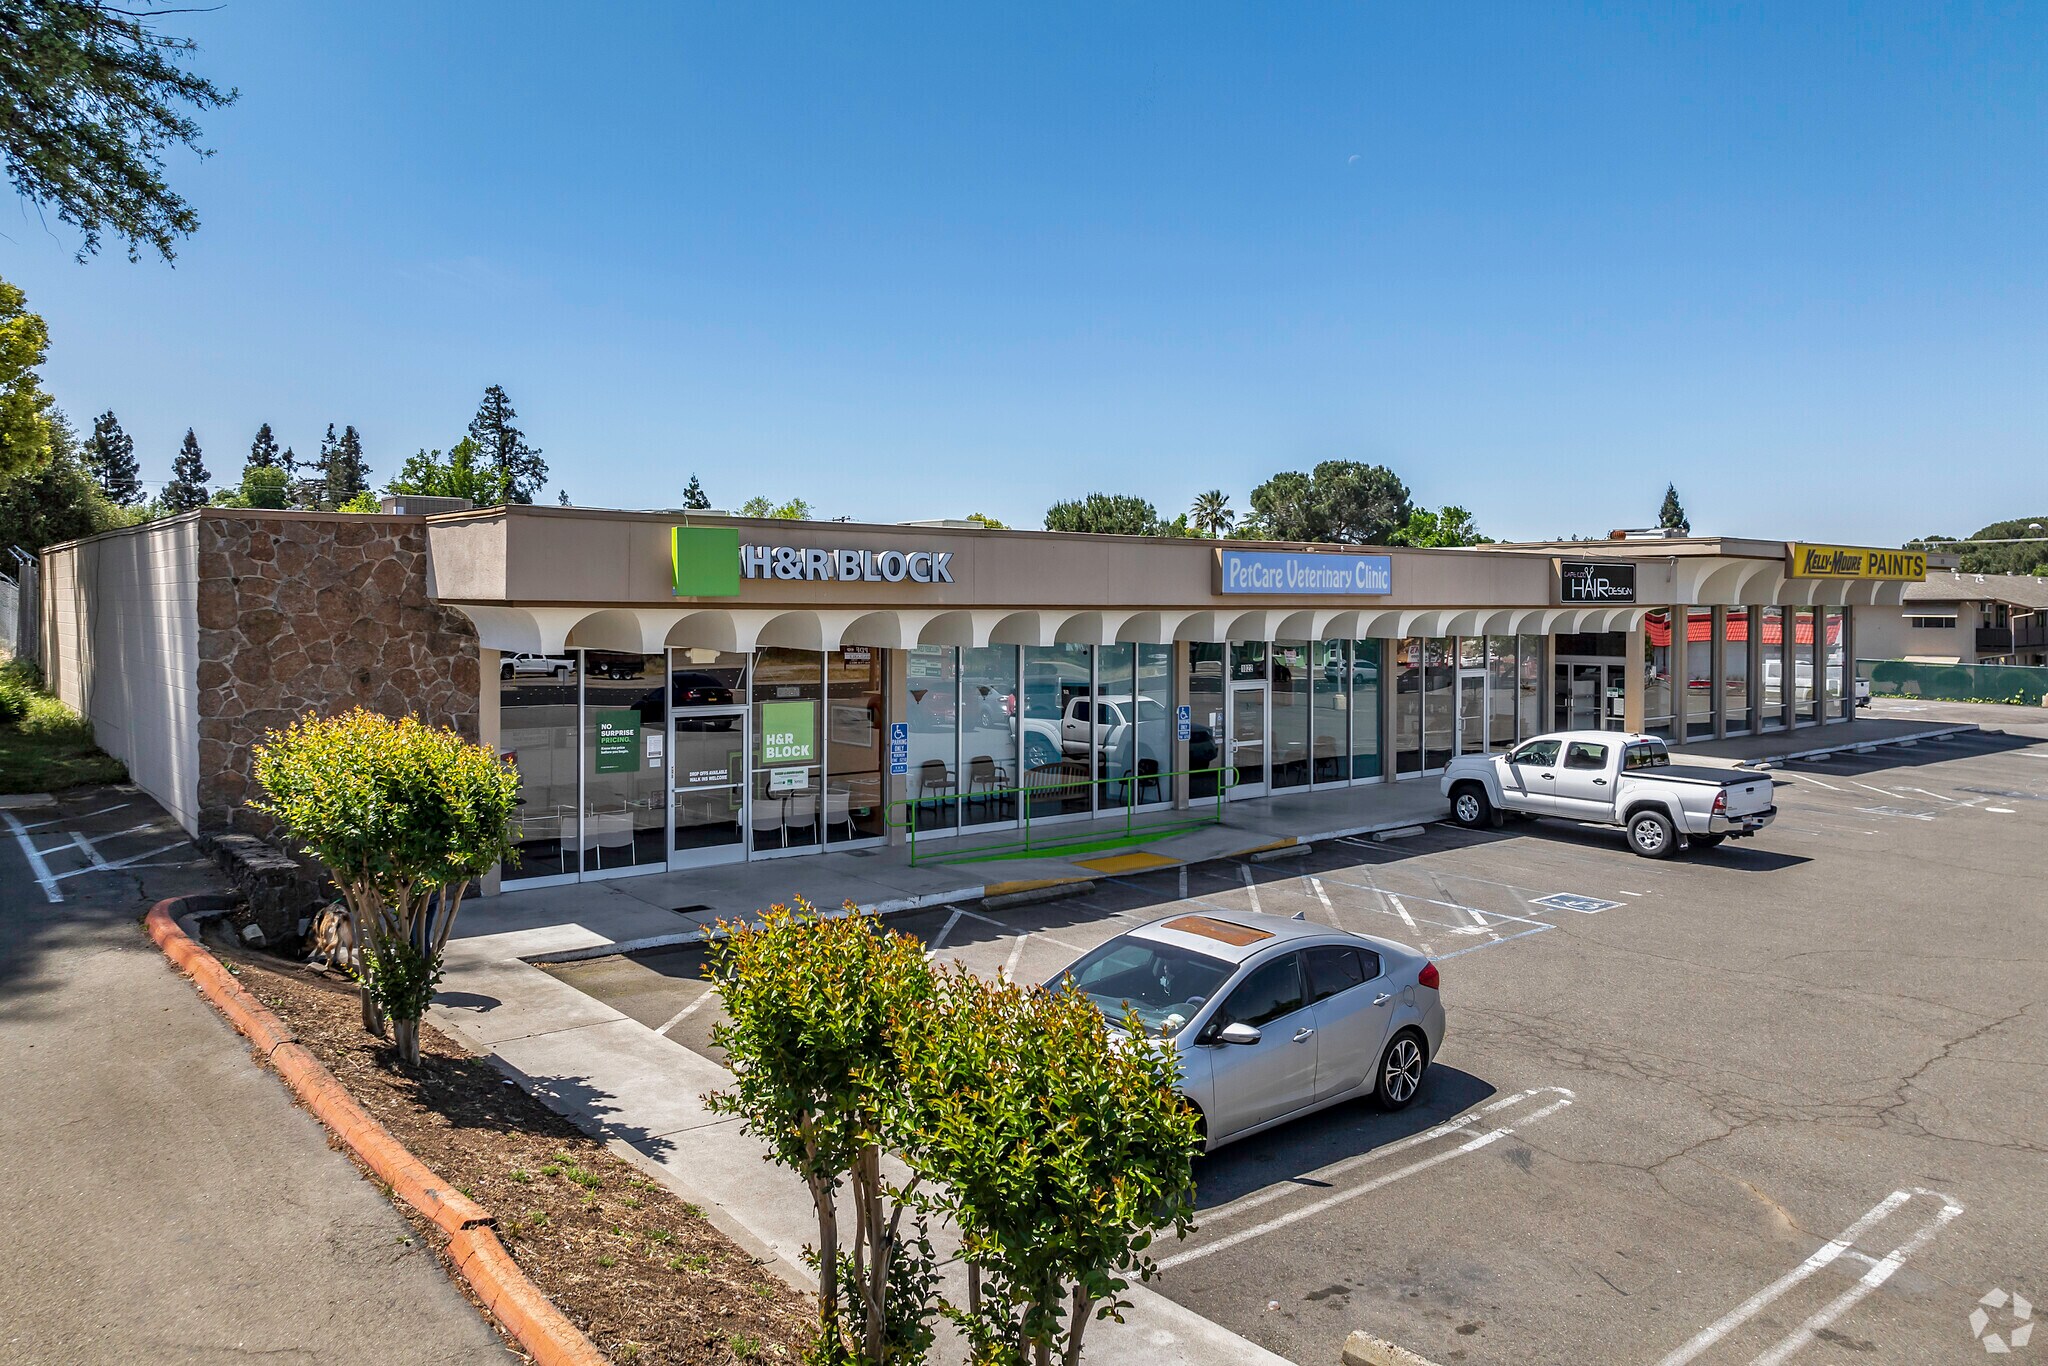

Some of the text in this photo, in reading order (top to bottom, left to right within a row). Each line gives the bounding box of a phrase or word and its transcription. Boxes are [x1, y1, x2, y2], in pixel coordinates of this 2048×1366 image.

[745, 545, 955, 583] H&R BLOCK
[1230, 558, 1388, 589] PetCare Veterinary Clinic
[1868, 553, 1923, 576] PAINTS
[1571, 575, 1632, 599] HAIR DESIGN
[766, 733, 794, 745] H&R
[766, 745, 810, 758] BLOCK
